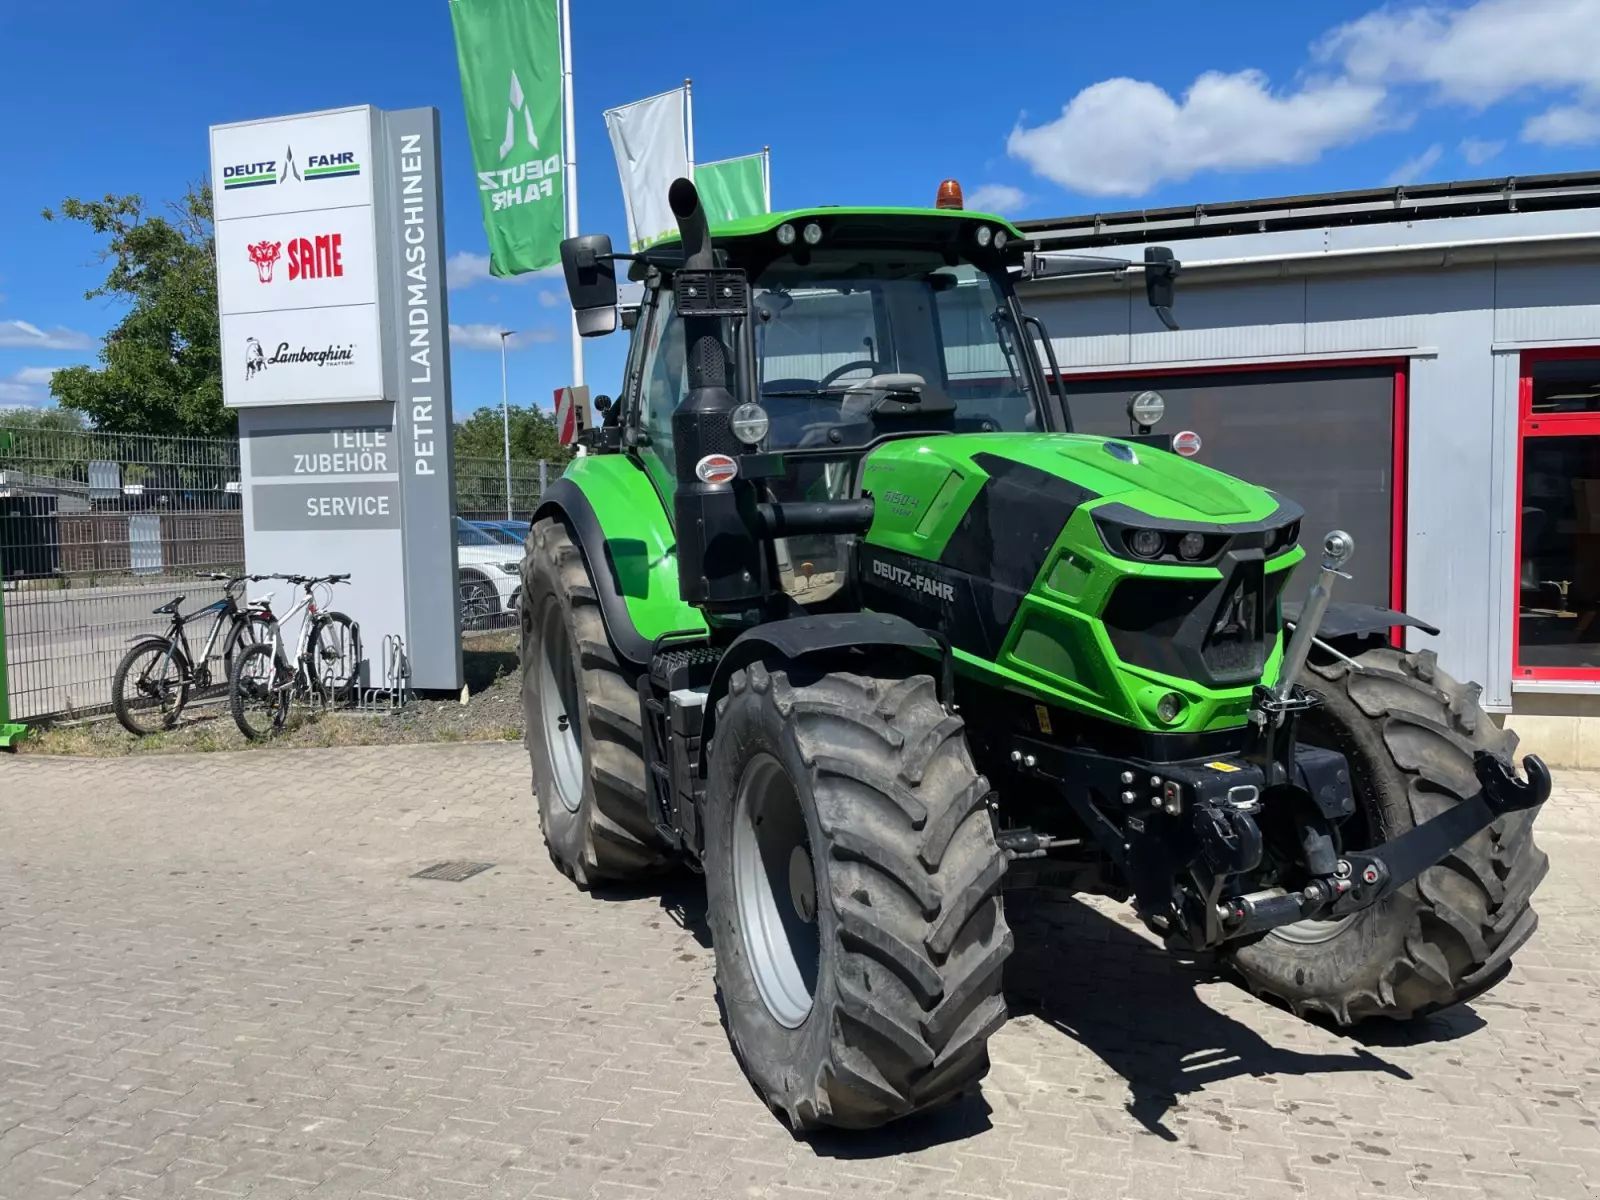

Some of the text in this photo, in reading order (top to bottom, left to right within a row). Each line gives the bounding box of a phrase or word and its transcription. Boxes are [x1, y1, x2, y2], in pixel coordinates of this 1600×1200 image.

[223, 151, 354, 178] DEUTZ FAHR
[287, 233, 343, 281] SAME
[400, 134, 435, 475] PETRI LANDMASCHINEN
[267, 342, 354, 367] Lamborghini
[330, 428, 387, 448] TEILE
[293, 448, 388, 473] ZUBEHÖR
[306, 496, 389, 517] SERVICE
[873, 559, 954, 602] DEUTZ-FAHR
